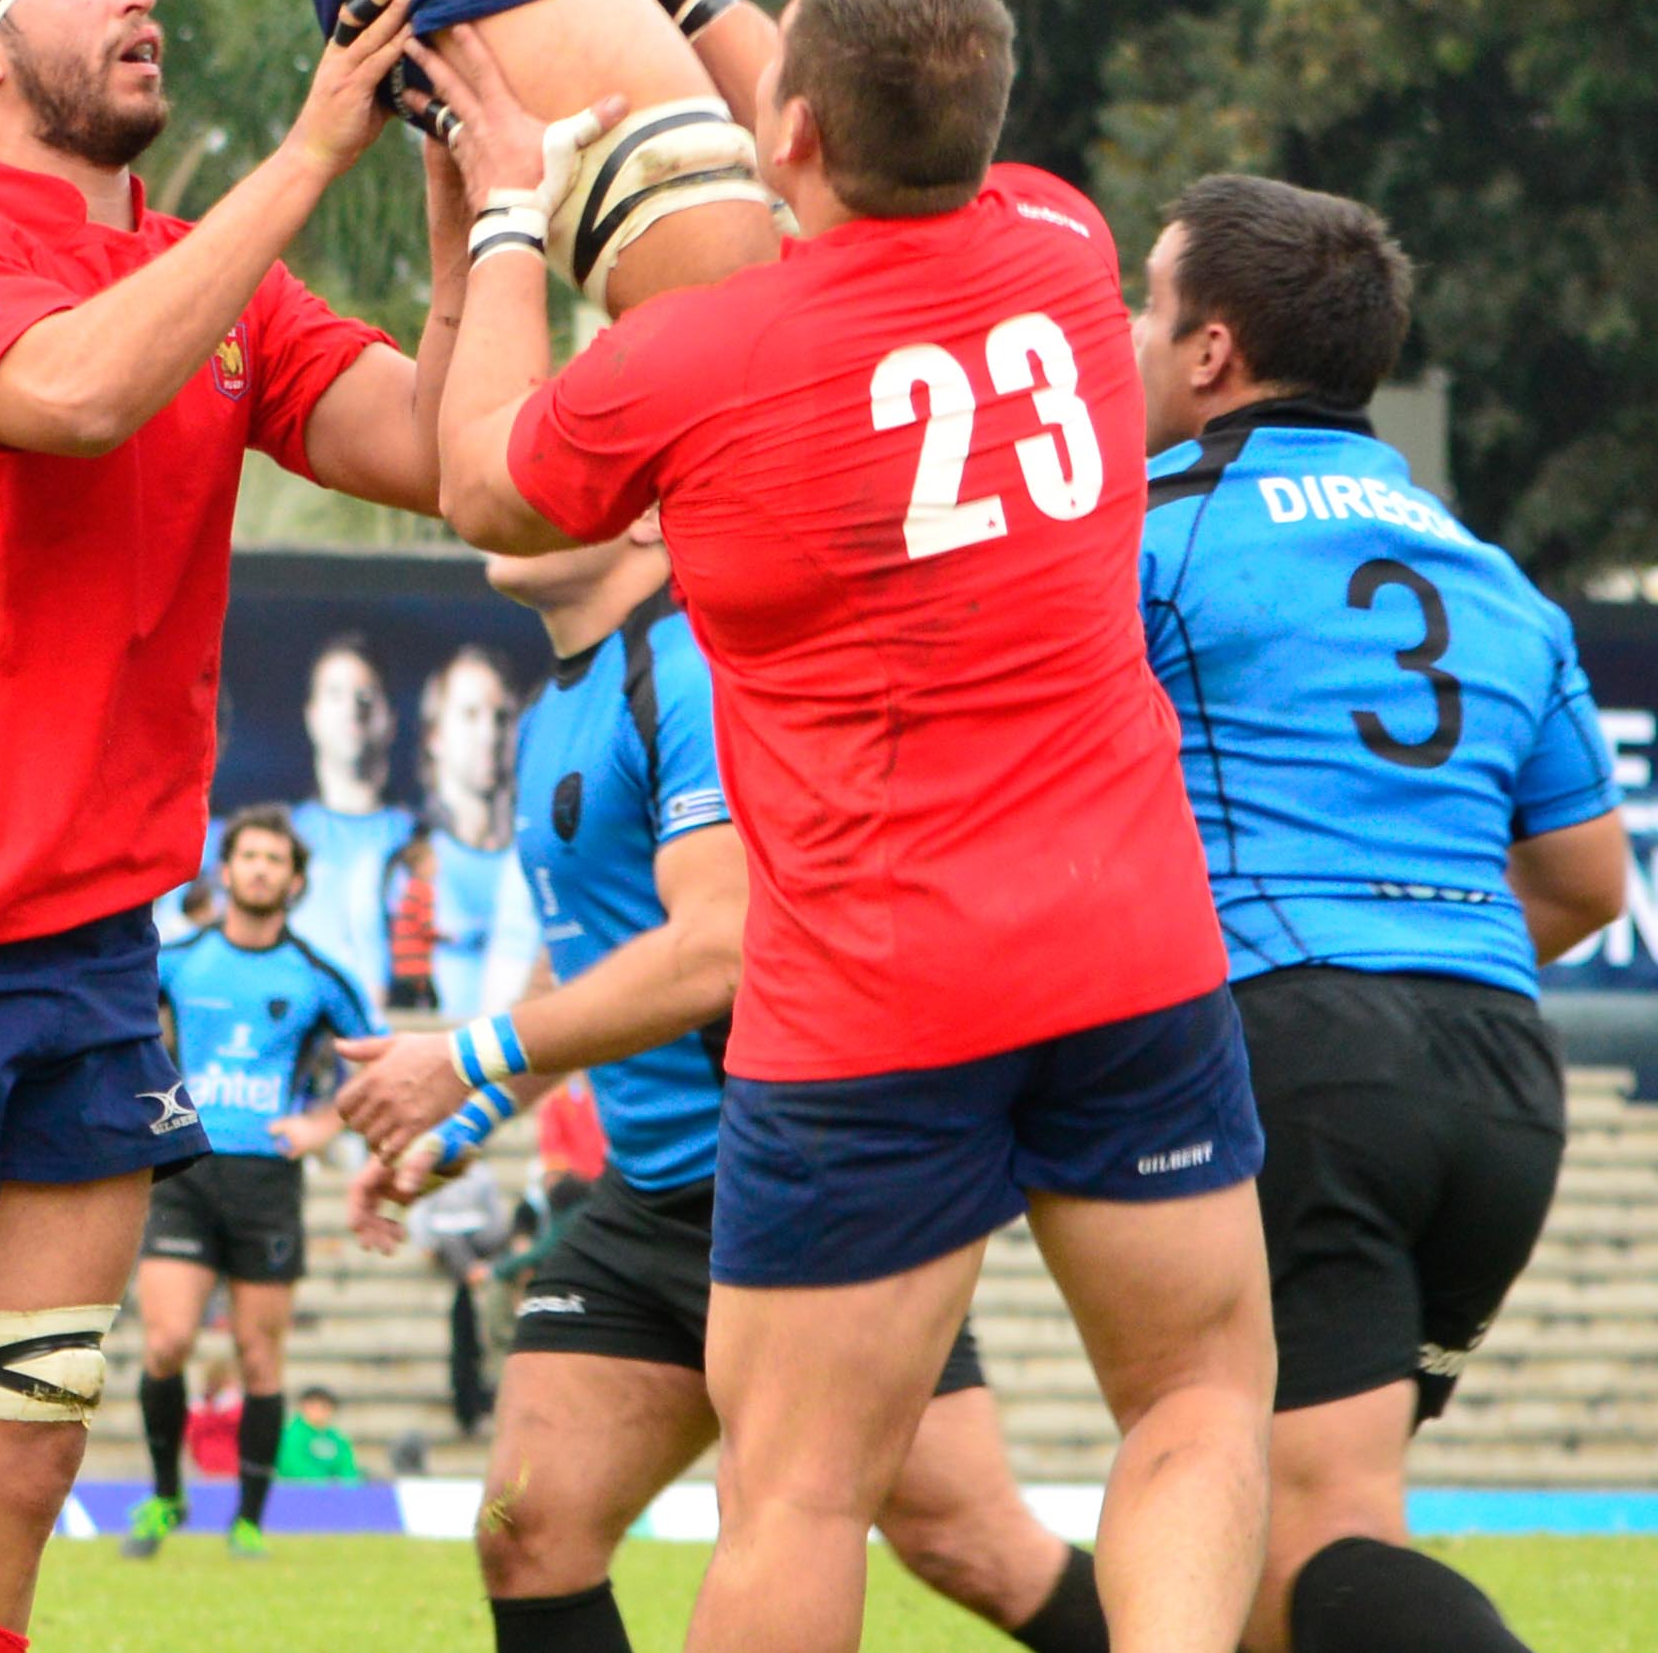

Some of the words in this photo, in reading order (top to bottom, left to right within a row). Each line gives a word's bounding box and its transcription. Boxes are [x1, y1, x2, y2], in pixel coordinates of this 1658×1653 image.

[870, 312, 1103, 560] 23
[1346, 558, 1464, 770] 3
[1137, 1140, 1213, 1176] GILBERT
